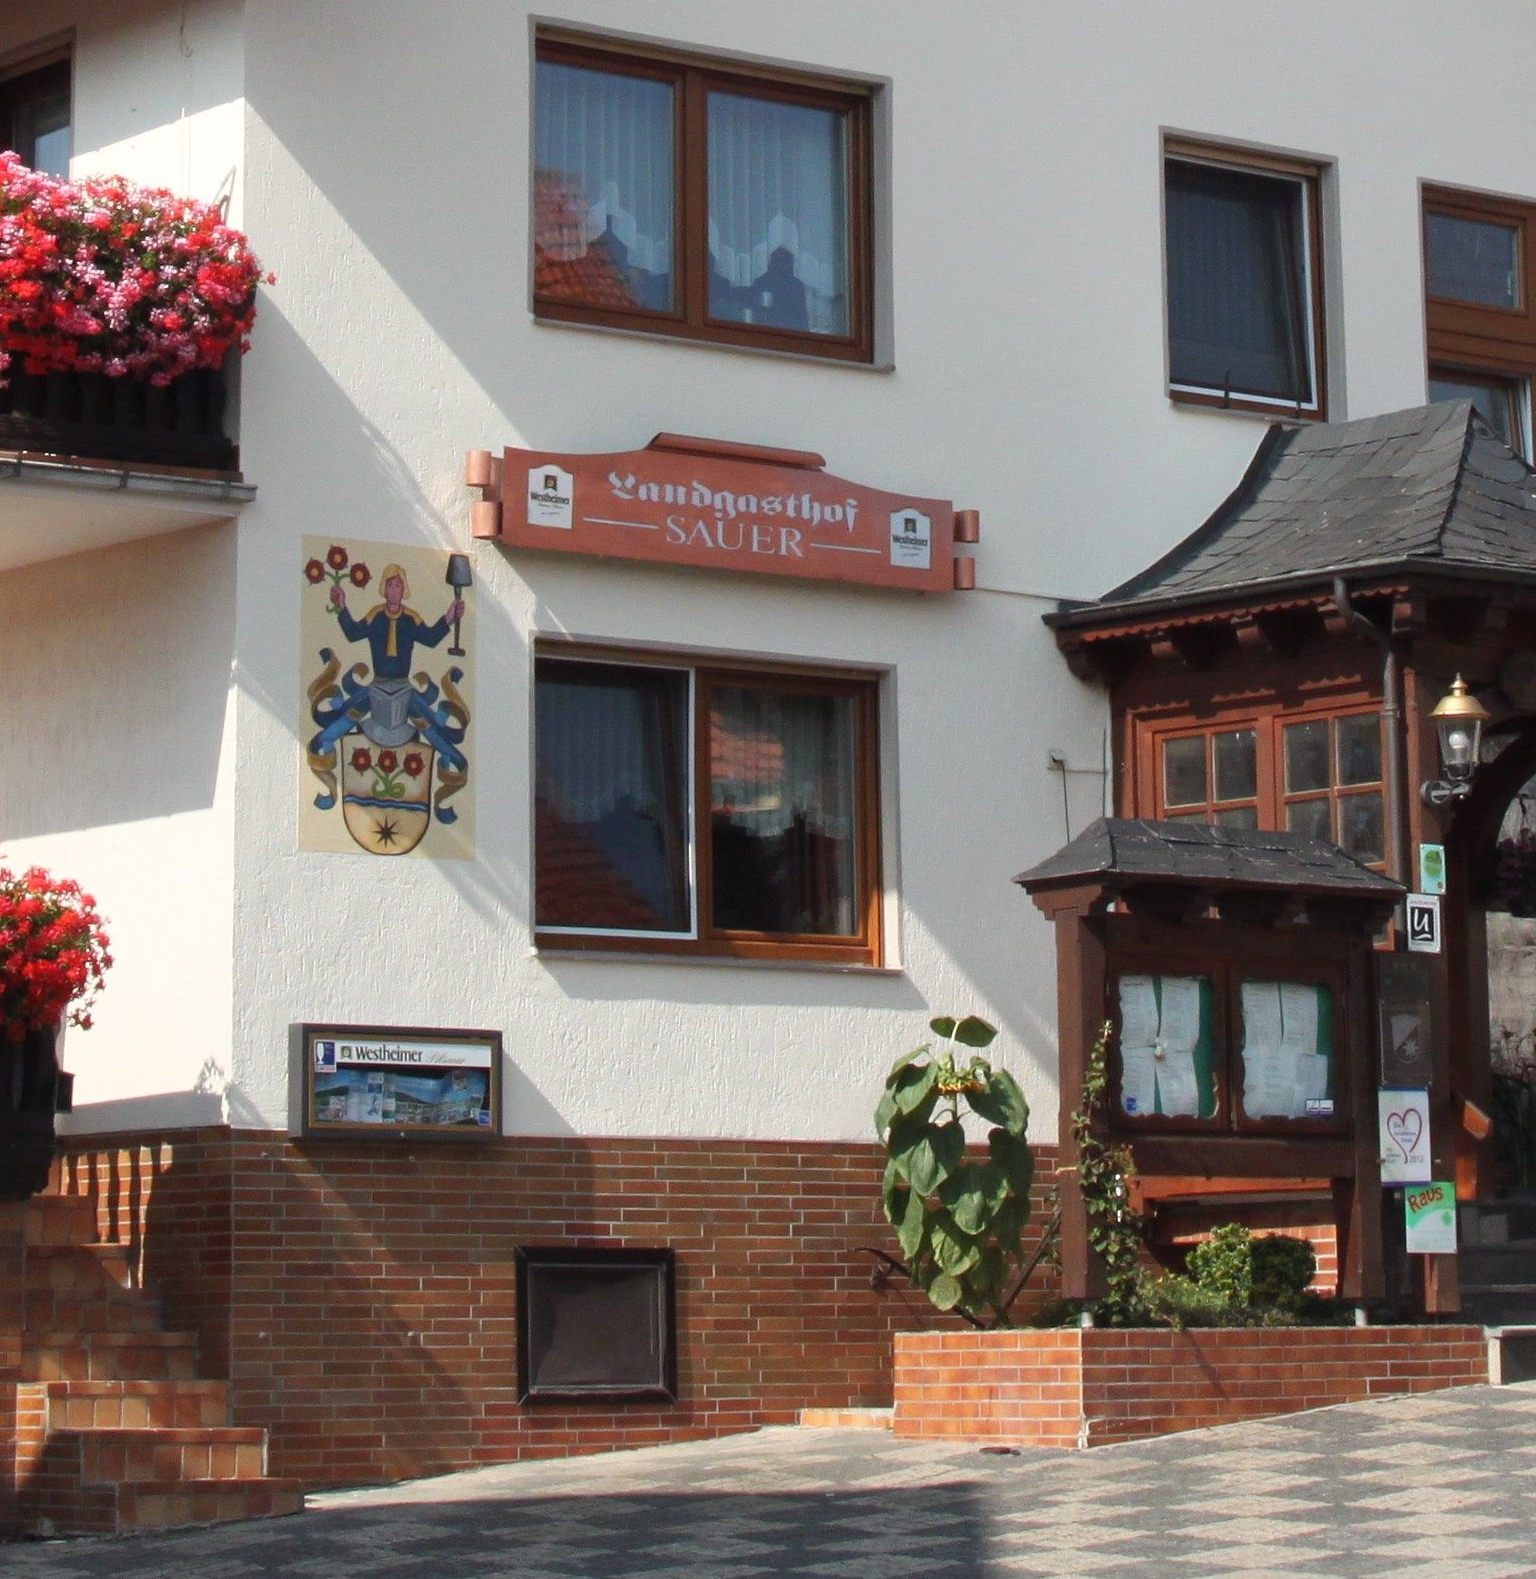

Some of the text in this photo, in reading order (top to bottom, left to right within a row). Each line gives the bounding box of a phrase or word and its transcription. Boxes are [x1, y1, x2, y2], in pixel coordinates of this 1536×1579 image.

[608, 471, 859, 533] Landgasthof
[665, 515, 804, 558] SAUER
[356, 1044, 423, 1063] Westheimer
